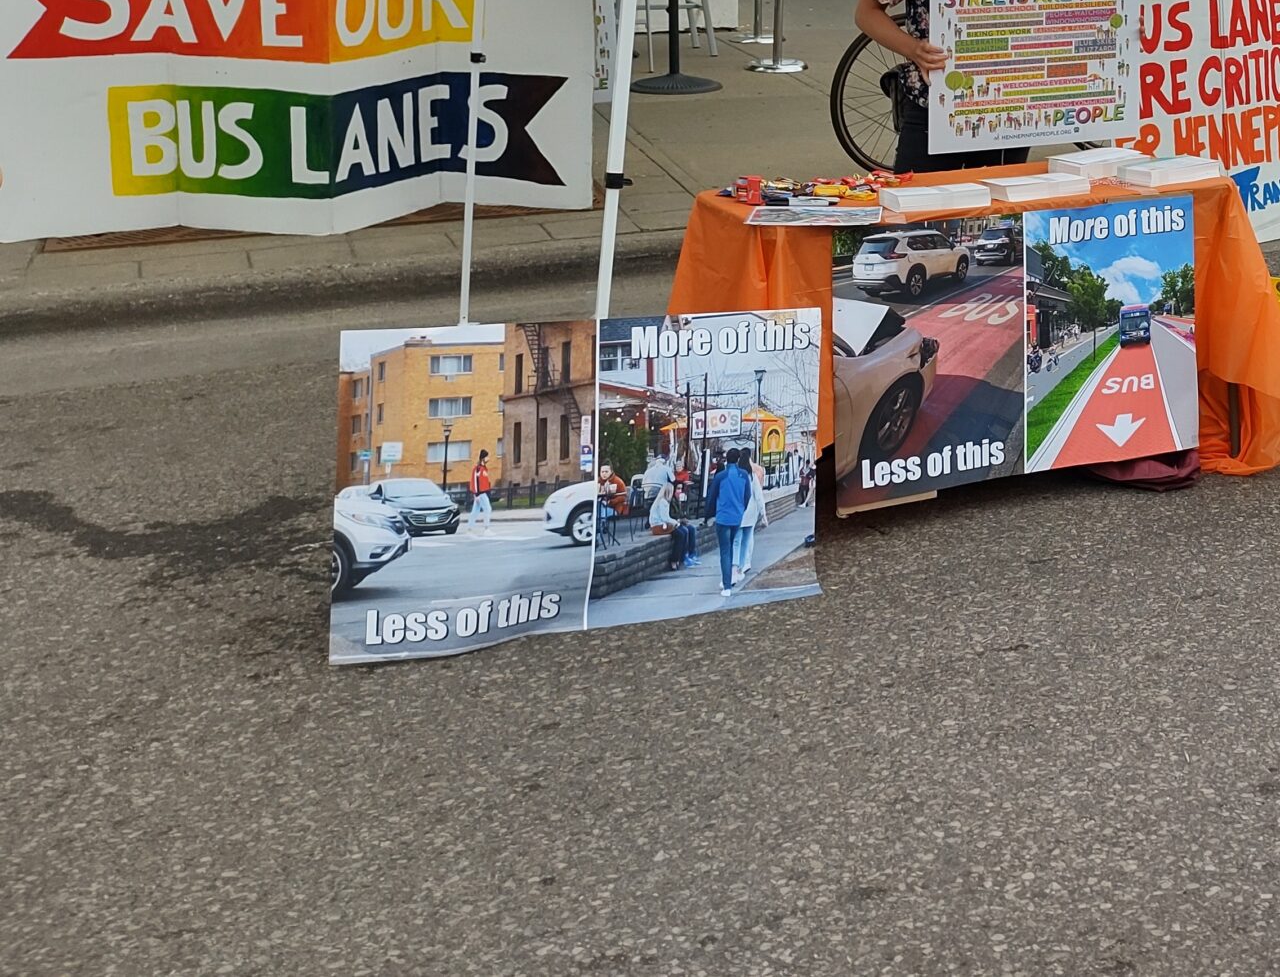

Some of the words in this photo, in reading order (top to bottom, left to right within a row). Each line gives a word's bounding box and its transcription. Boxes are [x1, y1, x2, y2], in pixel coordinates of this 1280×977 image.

[1006, 4, 1037, 12] SCHOOL
[967, 30, 993, 38] BIKING
[1139, 1, 1193, 55] US
[1002, 80, 1048, 89] WELCOMING
[1050, 77, 1087, 86] EVERYONE
[1139, 58, 1192, 120] RE
[954, 108, 989, 116] GROWING
[996, 105, 1024, 113] GARDEN
[1053, 104, 1126, 127] PEOPLE
[126, 98, 264, 181] BUS
[289, 84, 509, 185] LANES
[1048, 214, 1109, 246] More
[1113, 208, 1138, 238] of
[1140, 204, 1185, 235] this
[939, 291, 1021, 325] BUS
[630, 324, 714, 360] More
[718, 320, 751, 355] of
[753, 318, 811, 353] this
[1101, 374, 1154, 395] BUS
[860, 454, 922, 491] Less
[926, 445, 953, 477] of
[955, 437, 1005, 471] this
[364, 608, 449, 646] Less
[455, 600, 494, 638] of
[497, 591, 562, 630] this
